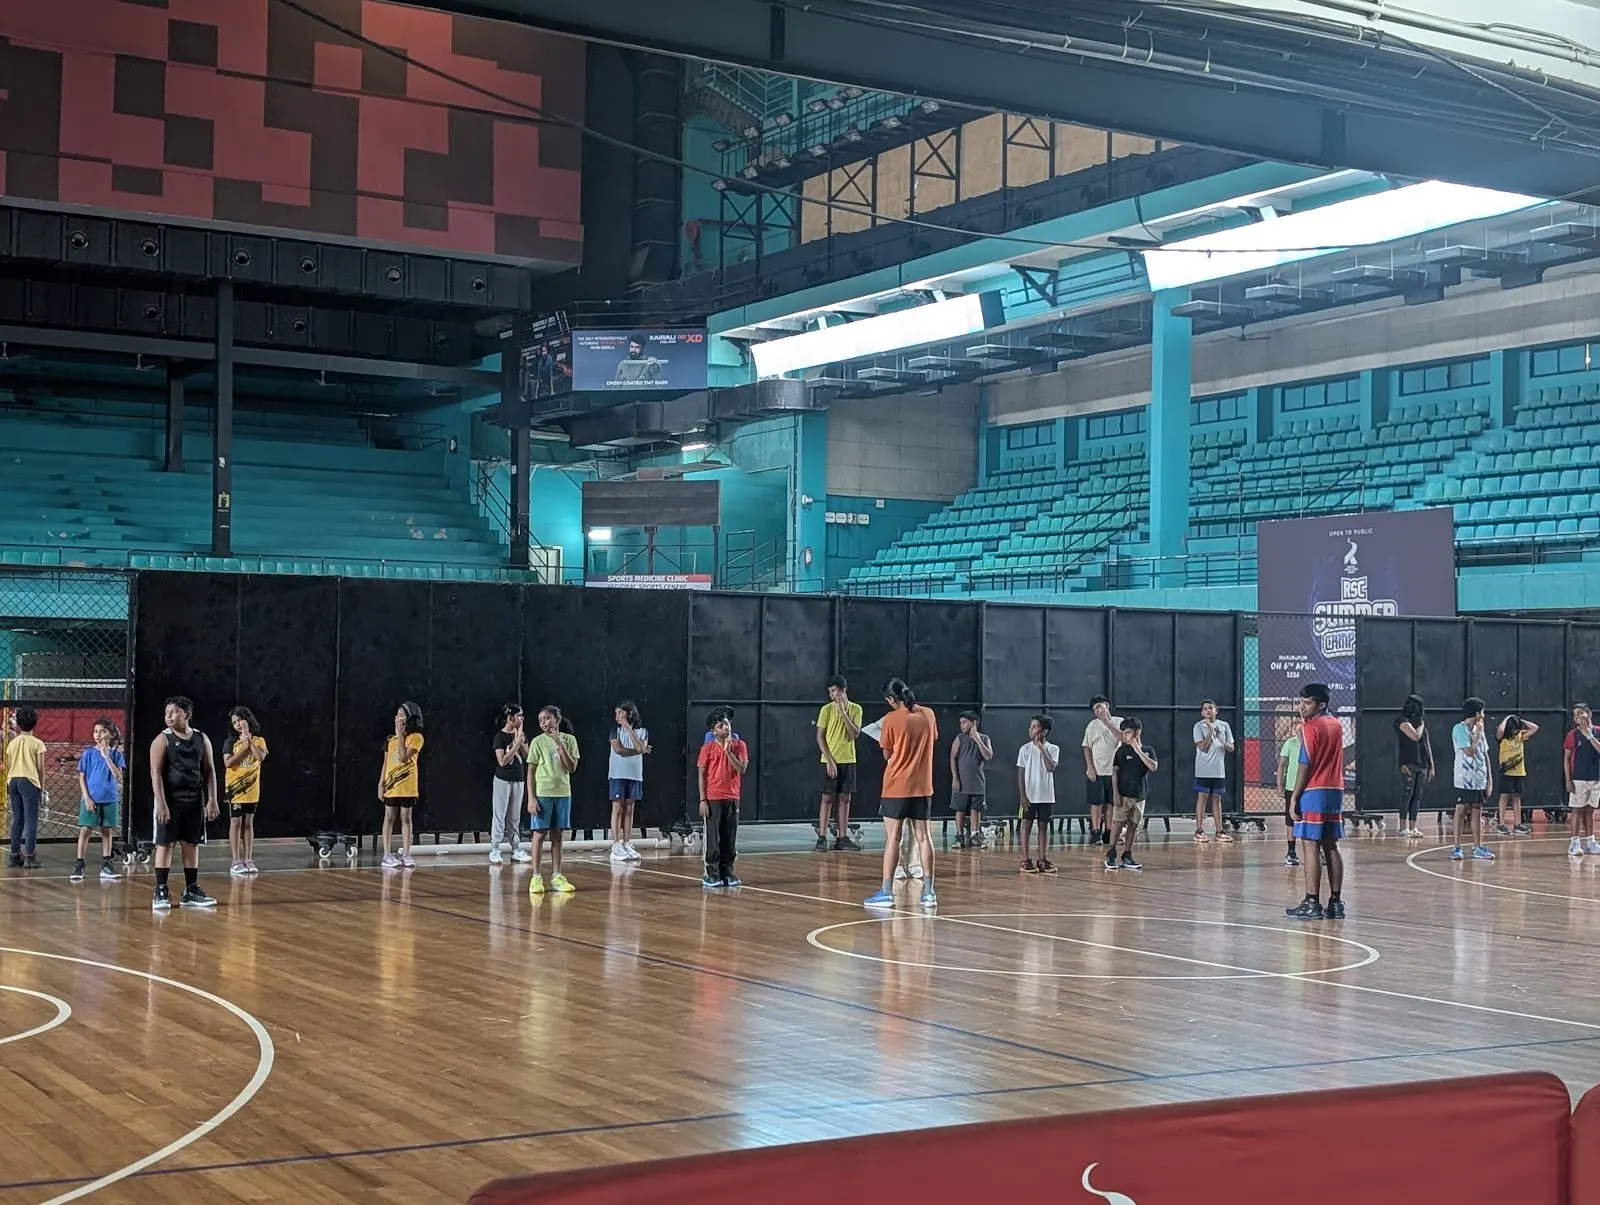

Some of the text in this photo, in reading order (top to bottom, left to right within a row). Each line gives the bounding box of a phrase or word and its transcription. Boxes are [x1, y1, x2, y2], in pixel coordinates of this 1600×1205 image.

[686, 334, 703, 343] XD
[1353, 527, 1374, 535] PUBLIC
[666, 575, 689, 583] CLINIC
[1343, 579, 1366, 599] RSC
[1270, 662, 1281, 671] ON
[1295, 662, 1317, 671] APRIL
[1286, 671, 1300, 679] 2026
